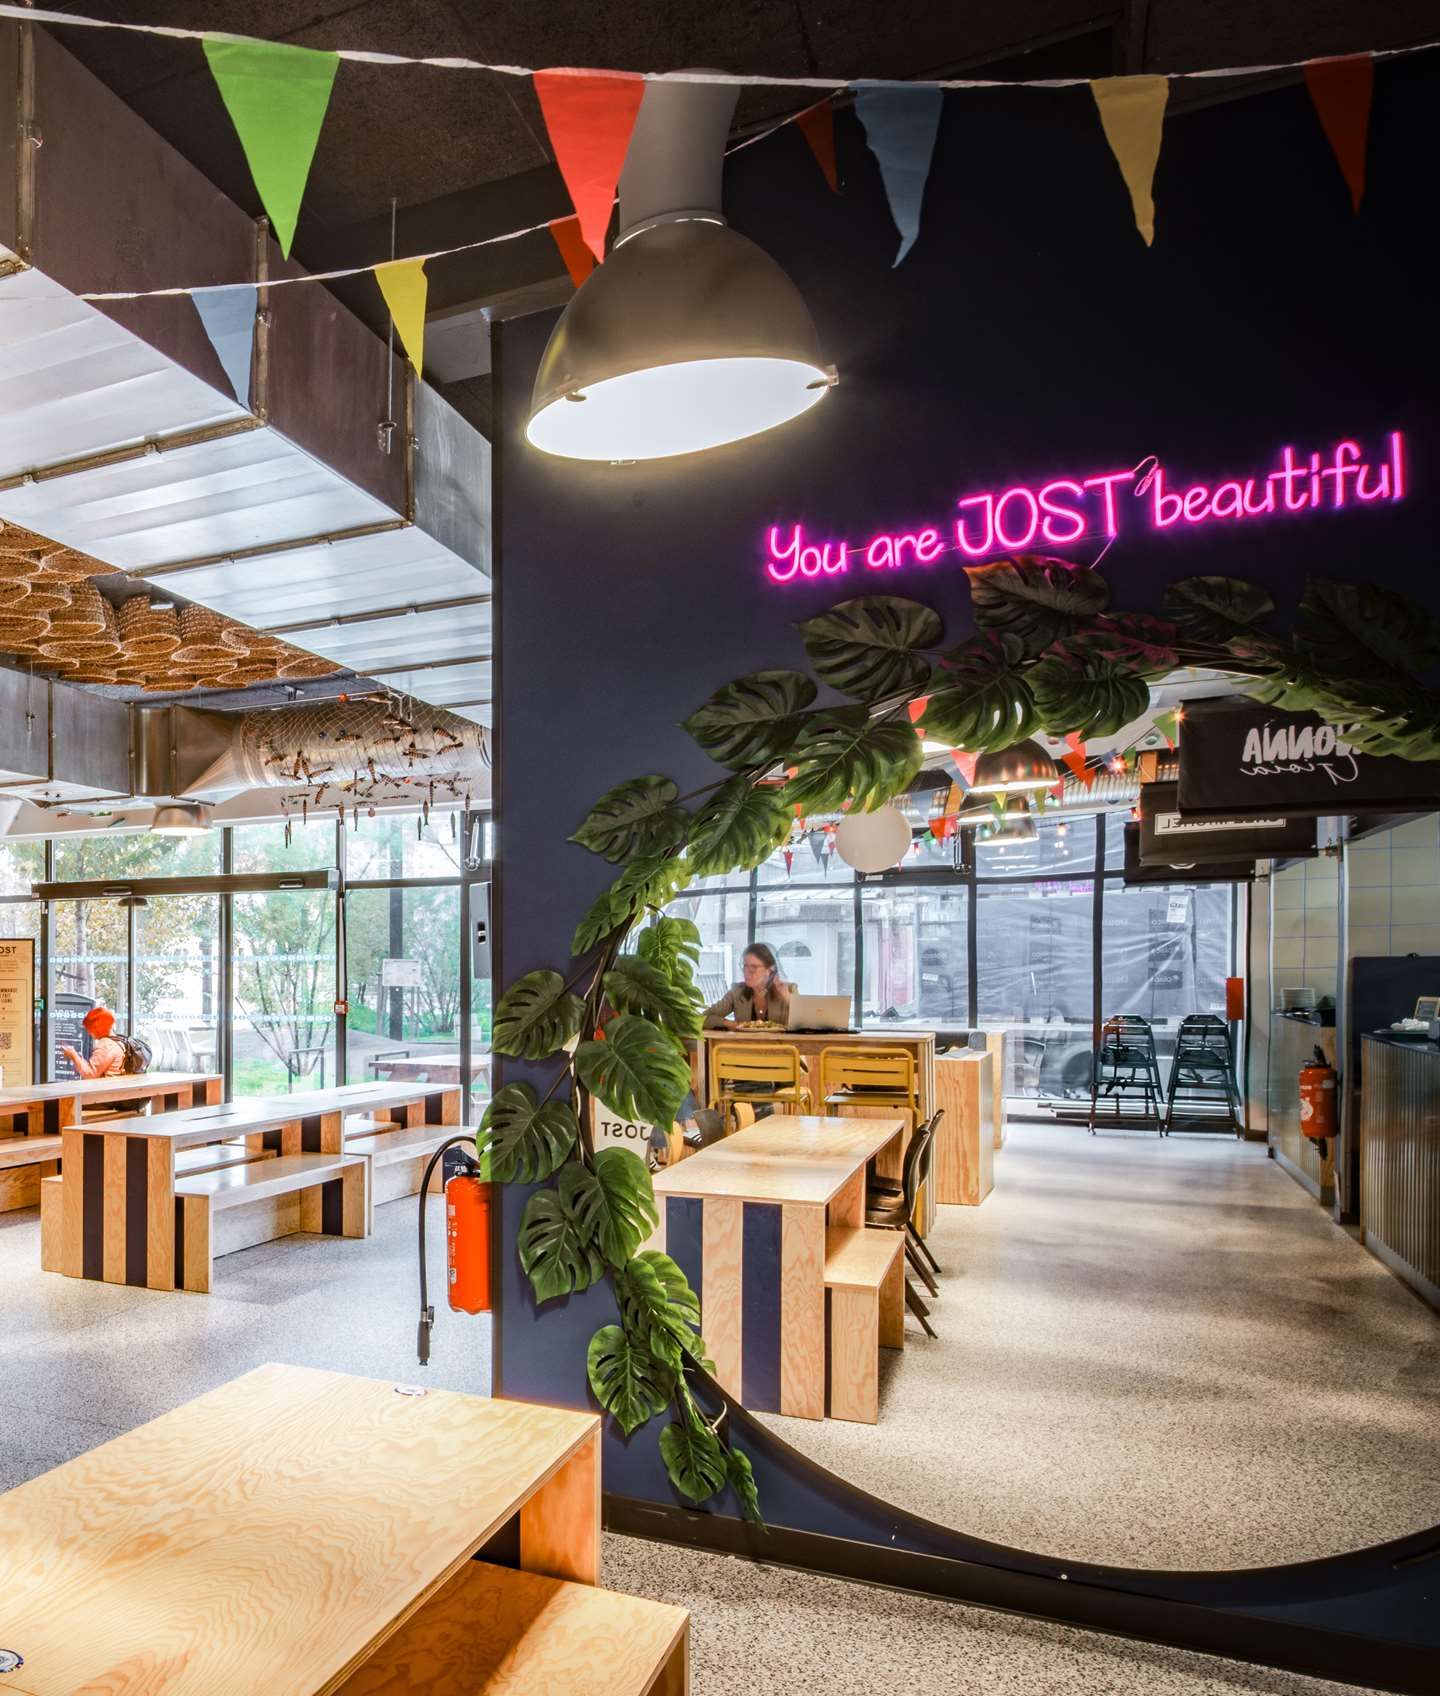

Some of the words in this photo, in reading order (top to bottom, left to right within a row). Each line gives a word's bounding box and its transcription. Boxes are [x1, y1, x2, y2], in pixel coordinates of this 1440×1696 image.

[767, 524, 848, 581] You
[866, 528, 945, 569] are
[957, 472, 1136, 555] JOST
[1154, 431, 1403, 528] beautiful
